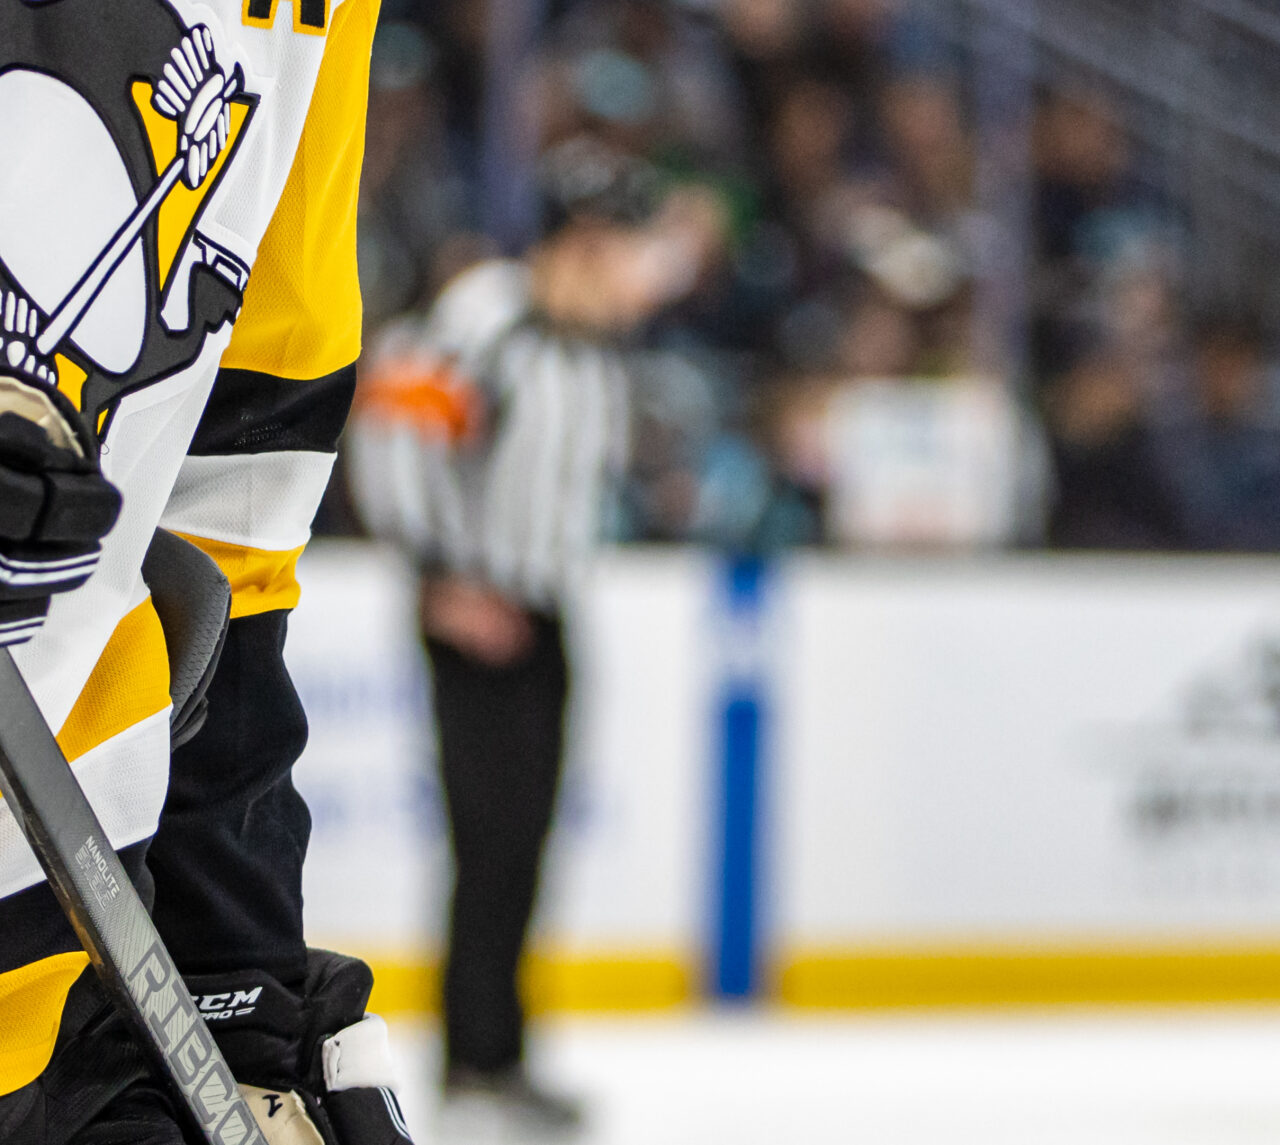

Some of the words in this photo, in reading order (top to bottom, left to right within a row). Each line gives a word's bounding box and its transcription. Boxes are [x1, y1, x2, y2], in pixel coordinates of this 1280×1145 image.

[85, 835, 120, 899] NANOLITE
[192, 986, 263, 1011] CM
[127, 940, 269, 1145] RIBCO
